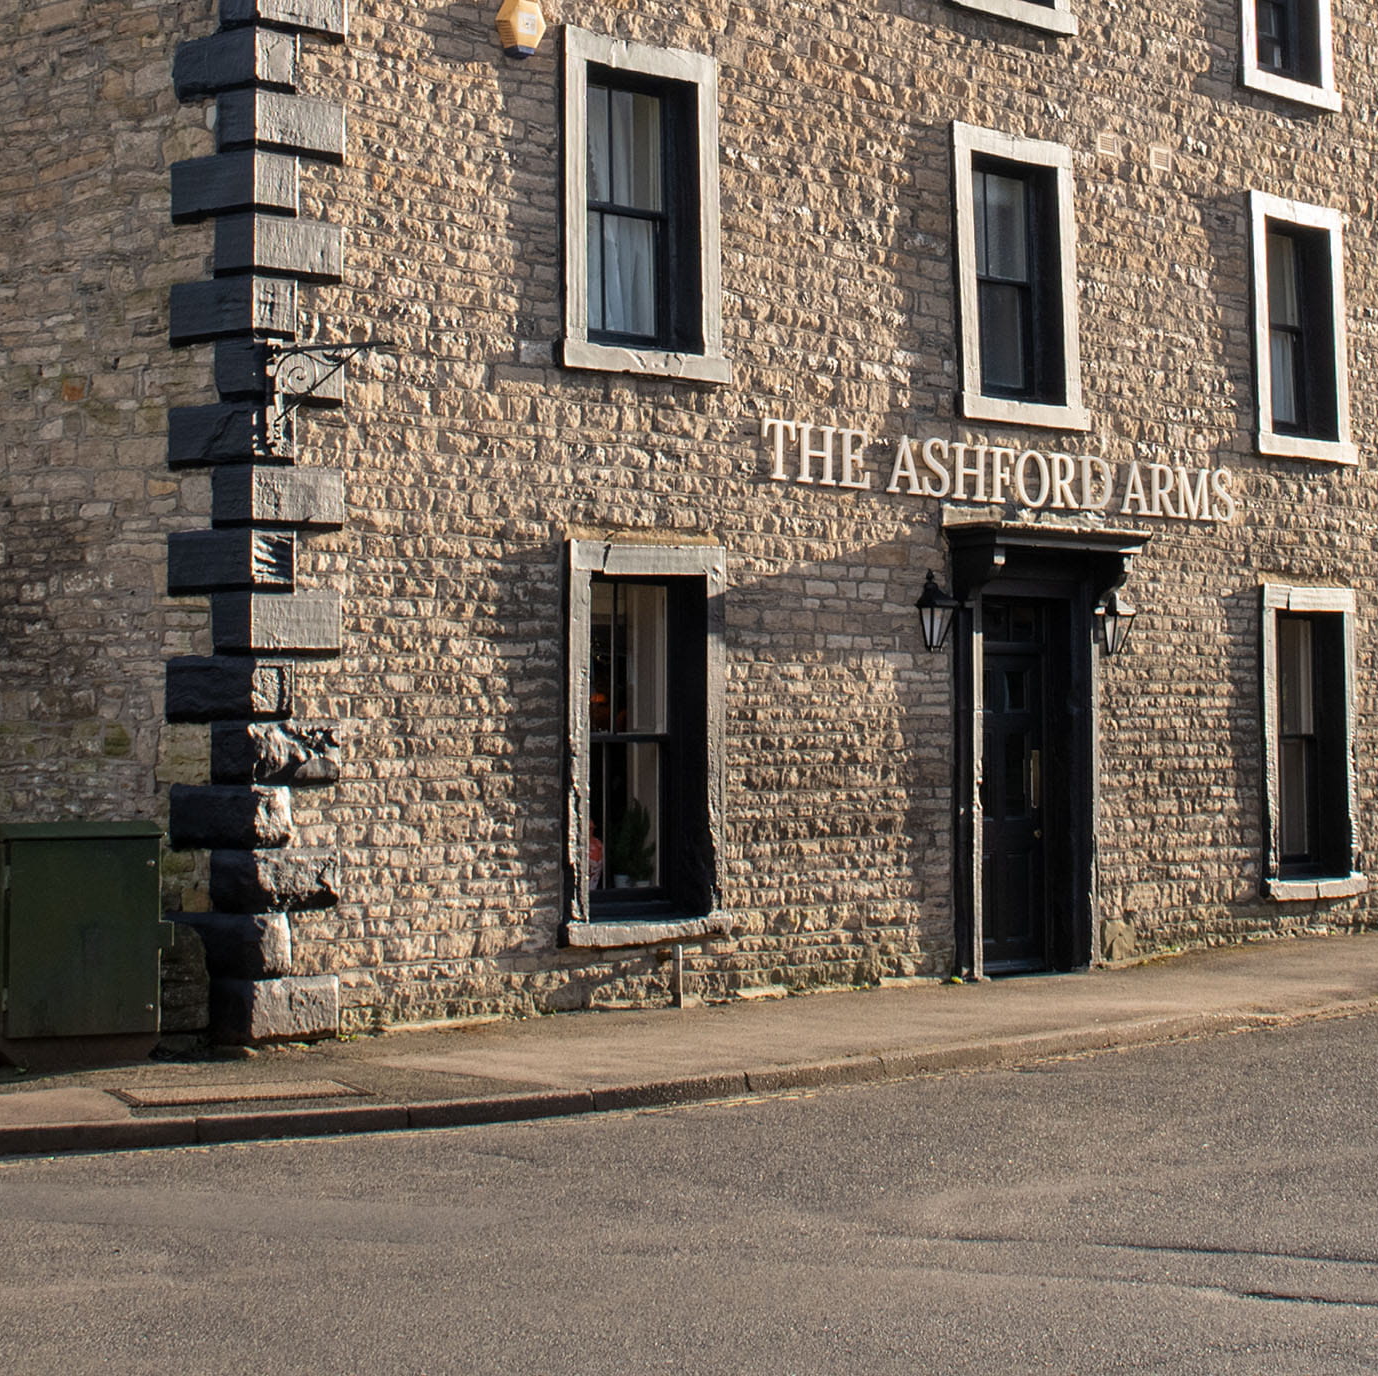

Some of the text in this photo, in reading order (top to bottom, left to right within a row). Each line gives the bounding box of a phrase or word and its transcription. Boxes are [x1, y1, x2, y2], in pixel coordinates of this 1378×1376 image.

[762, 418, 1237, 523] THE ASHFORD ARMS
